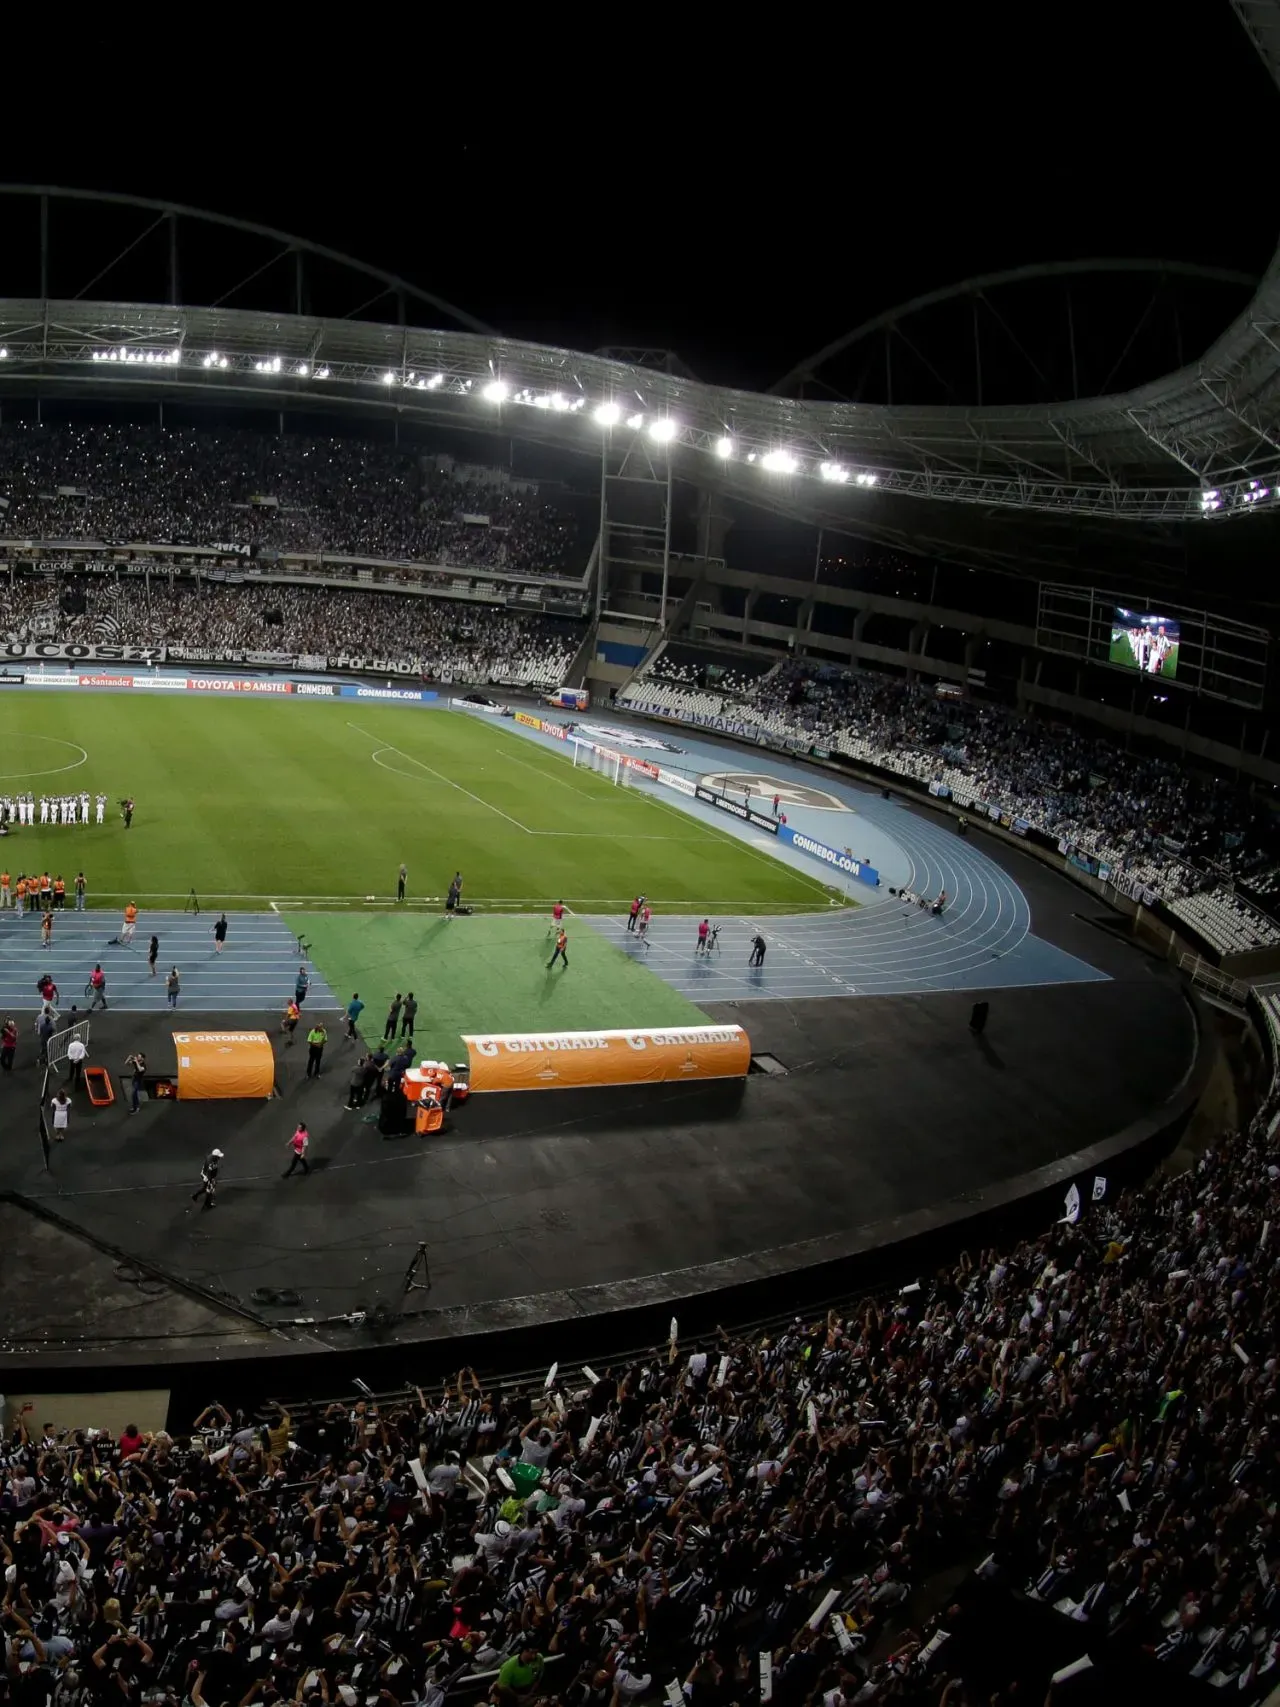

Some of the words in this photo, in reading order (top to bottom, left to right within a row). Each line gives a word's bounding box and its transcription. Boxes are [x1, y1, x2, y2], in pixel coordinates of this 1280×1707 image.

[91, 678, 130, 687] Santander
[191, 679, 235, 690] TOYOTA
[253, 683, 287, 692] AMSTEL
[297, 683, 335, 696] CONMEBOL
[357, 688, 422, 700] CONMEBOL.COM
[520, 714, 537, 726] DHL
[541, 722, 564, 739] TOYOTA
[792, 833, 860, 876] CONMEBOL.COM
[195, 1034, 265, 1042] GATORADE
[651, 1030, 740, 1046] GATORADE
[504, 1036, 609, 1053] GATORADE
